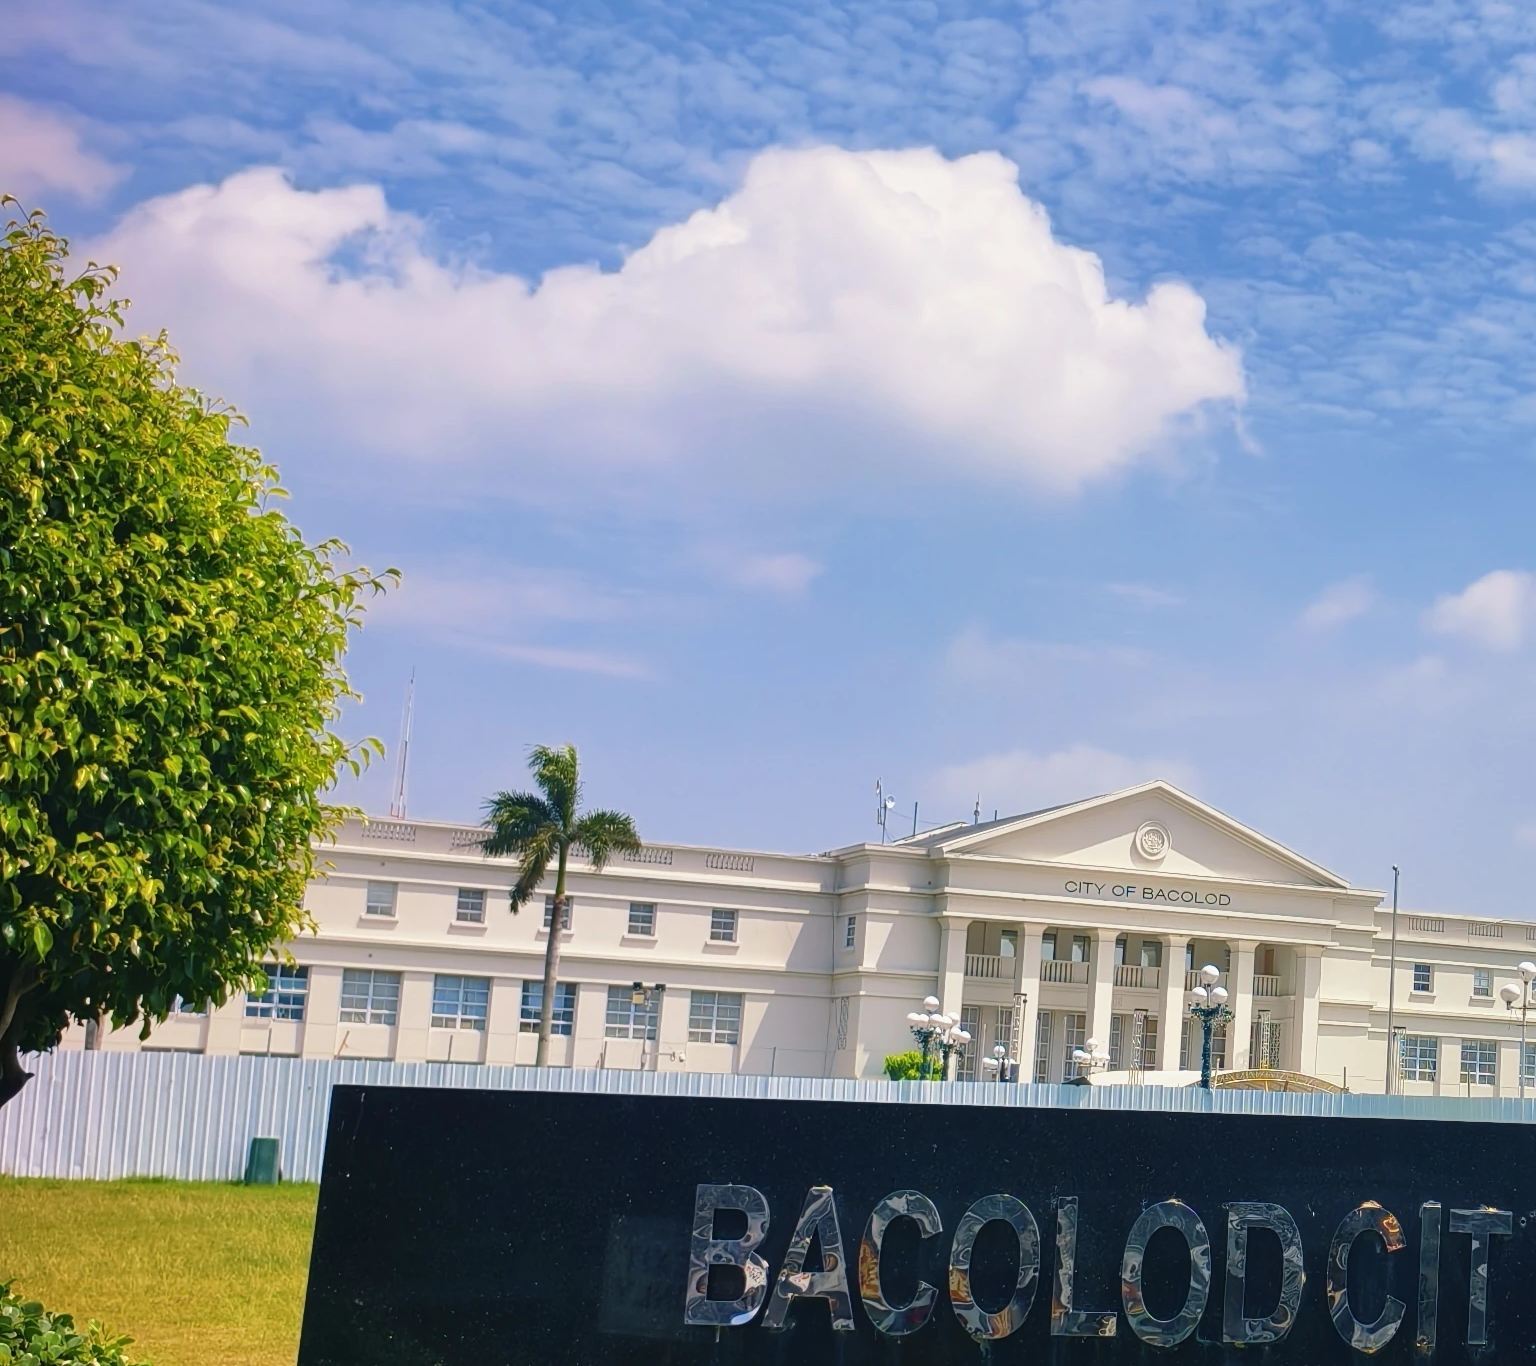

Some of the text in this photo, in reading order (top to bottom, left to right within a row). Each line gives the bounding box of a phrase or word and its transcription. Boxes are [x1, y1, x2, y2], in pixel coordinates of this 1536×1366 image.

[1064, 881, 1231, 906] CITY OF BACOLOD
[684, 1183, 1305, 1348] BACOLOD
